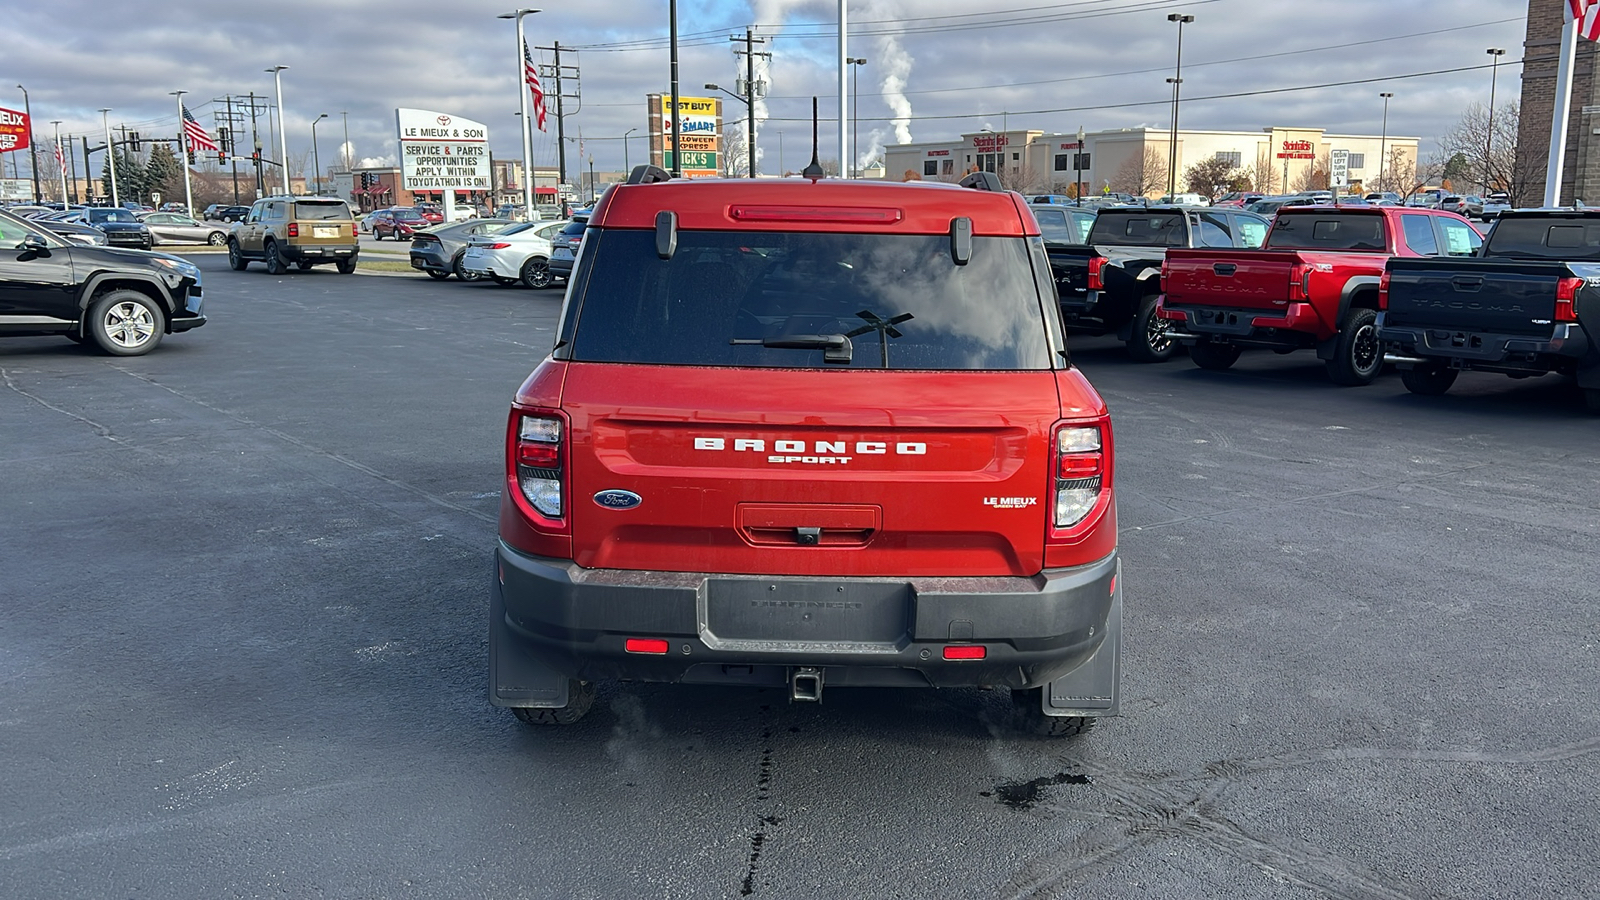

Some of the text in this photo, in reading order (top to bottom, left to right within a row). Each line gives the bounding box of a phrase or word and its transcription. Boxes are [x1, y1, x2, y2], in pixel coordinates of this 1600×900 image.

[665, 120, 714, 132] PSMART
[405, 128, 484, 138] LE MIEUX & SON
[406, 146, 483, 155] SERVICE & PARTS
[416, 157, 478, 166] OPPORTUNITIES
[681, 152, 707, 164] ICK'S
[415, 167, 476, 176] APPLY WITHIN
[407, 177, 487, 187] TOYOTATHON IS ON!
[1412, 299, 1524, 312] TACOMA
[694, 437, 927, 455] BRONCO
[768, 455, 852, 464] SPORT
[604, 493, 630, 505] Ford
[983, 497, 1037, 505] LE MIEUX
